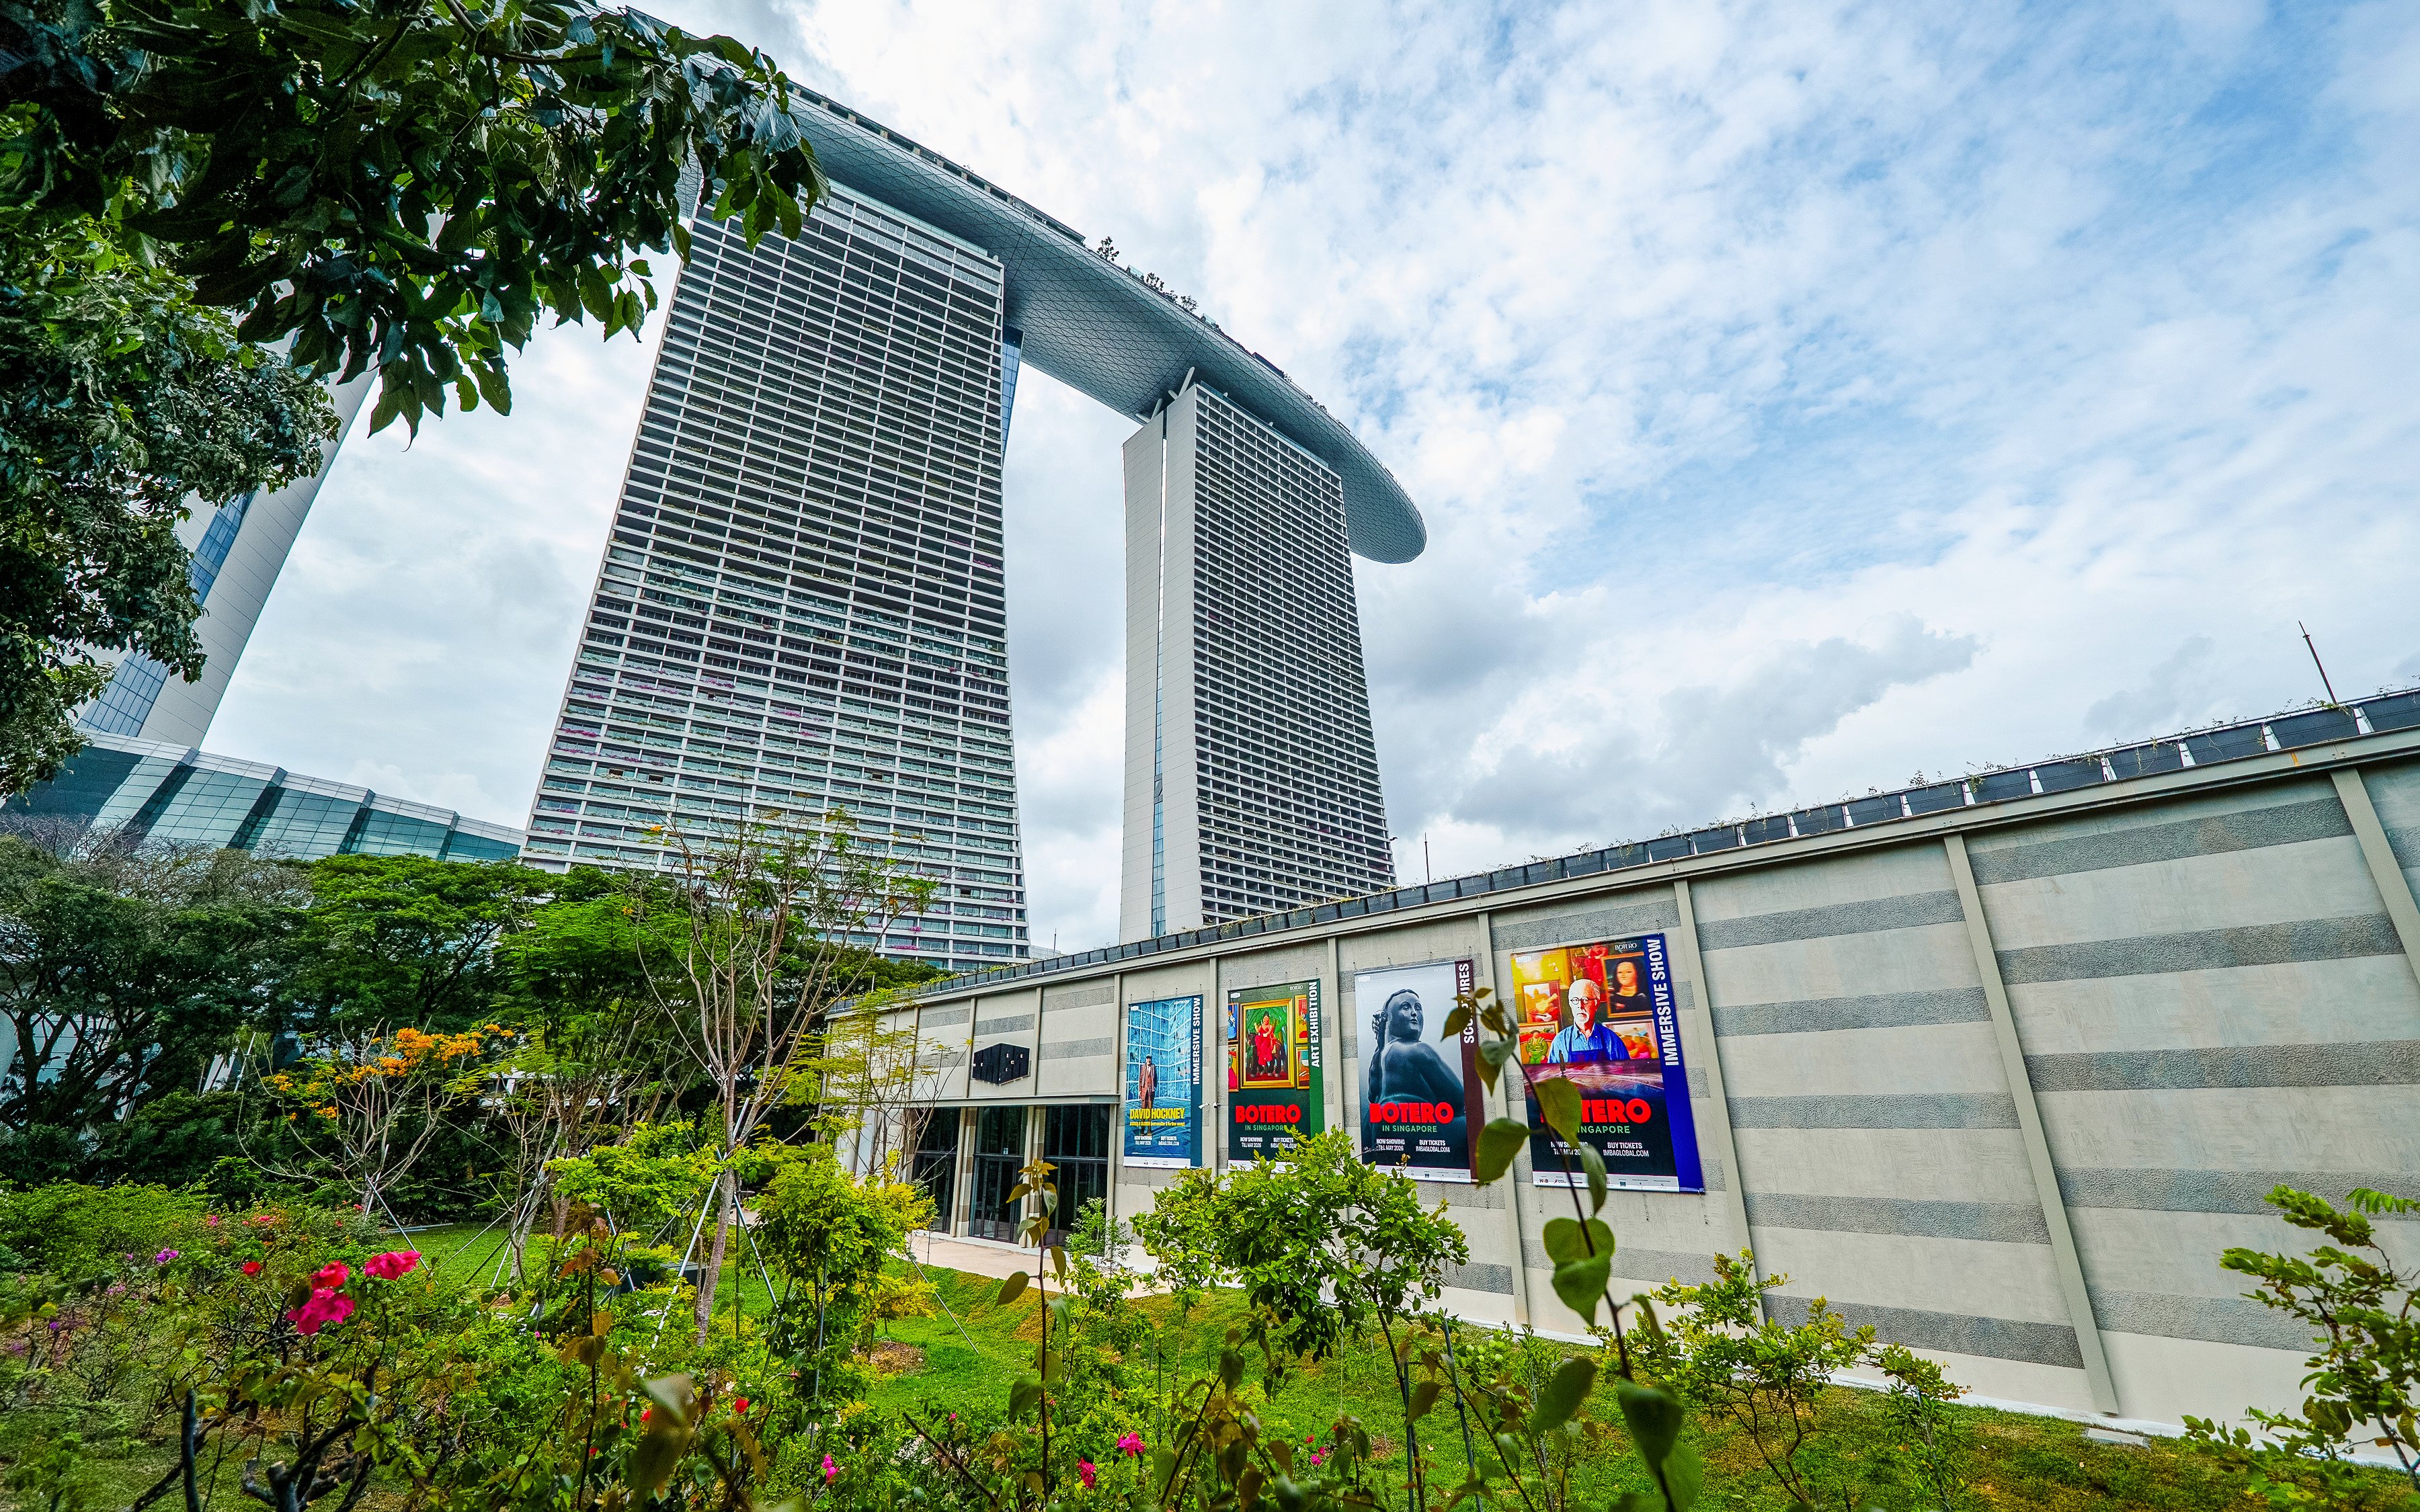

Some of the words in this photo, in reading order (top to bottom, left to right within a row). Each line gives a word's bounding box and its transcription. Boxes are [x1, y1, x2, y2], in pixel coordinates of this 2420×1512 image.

[1647, 939, 1666, 980] SHOW
[1193, 998, 1201, 1026] SHOW
[1308, 982, 1319, 1043] EXHIBITION
[1459, 963, 1475, 1044] SCURES
[1654, 983, 1679, 1066] IMMERSIVE
[1311, 1046, 1320, 1067] ART
[1129, 1108, 1151, 1120] DAVID
[1151, 1107, 1184, 1119] HOCKNEY
[1236, 1104, 1301, 1124] BOTERO
[1369, 1102, 1454, 1124] BOTERO
[1540, 1098, 1652, 1124] TERO
